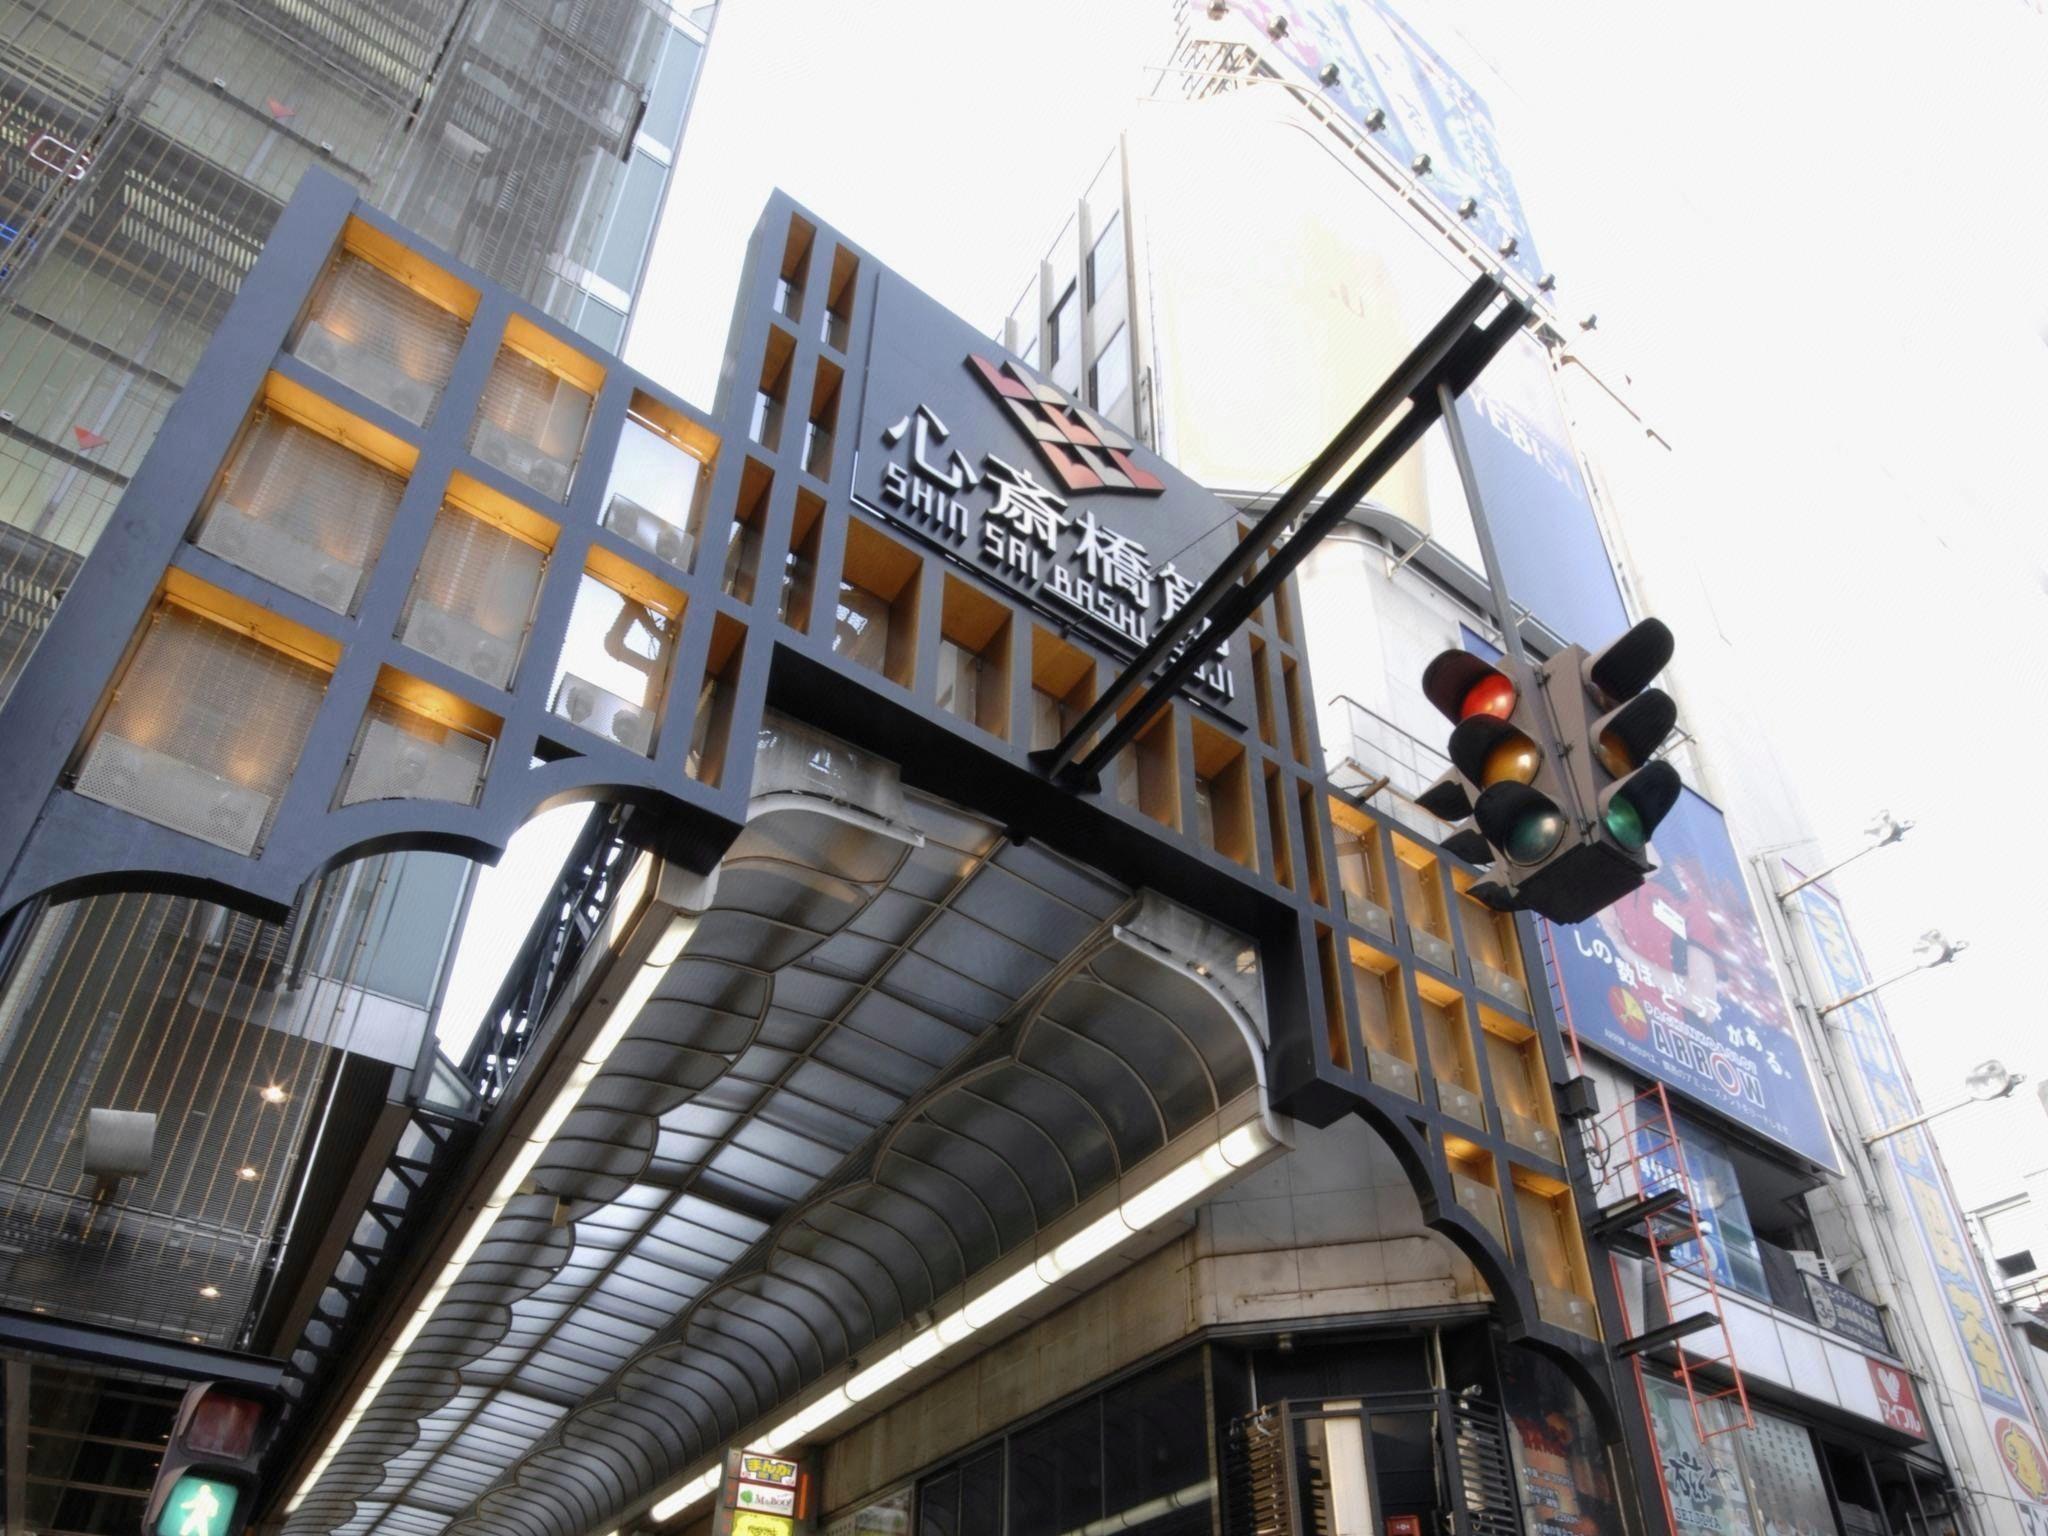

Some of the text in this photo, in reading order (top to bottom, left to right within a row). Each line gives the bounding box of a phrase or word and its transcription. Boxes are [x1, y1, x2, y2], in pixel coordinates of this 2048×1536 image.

[886, 461, 968, 537] SHIN
[985, 521, 1038, 581] SAI
[1053, 564, 1149, 646] BASHI
[1651, 1020, 1766, 1109] ARROW
[1878, 1396, 1921, 1434] アイフル
